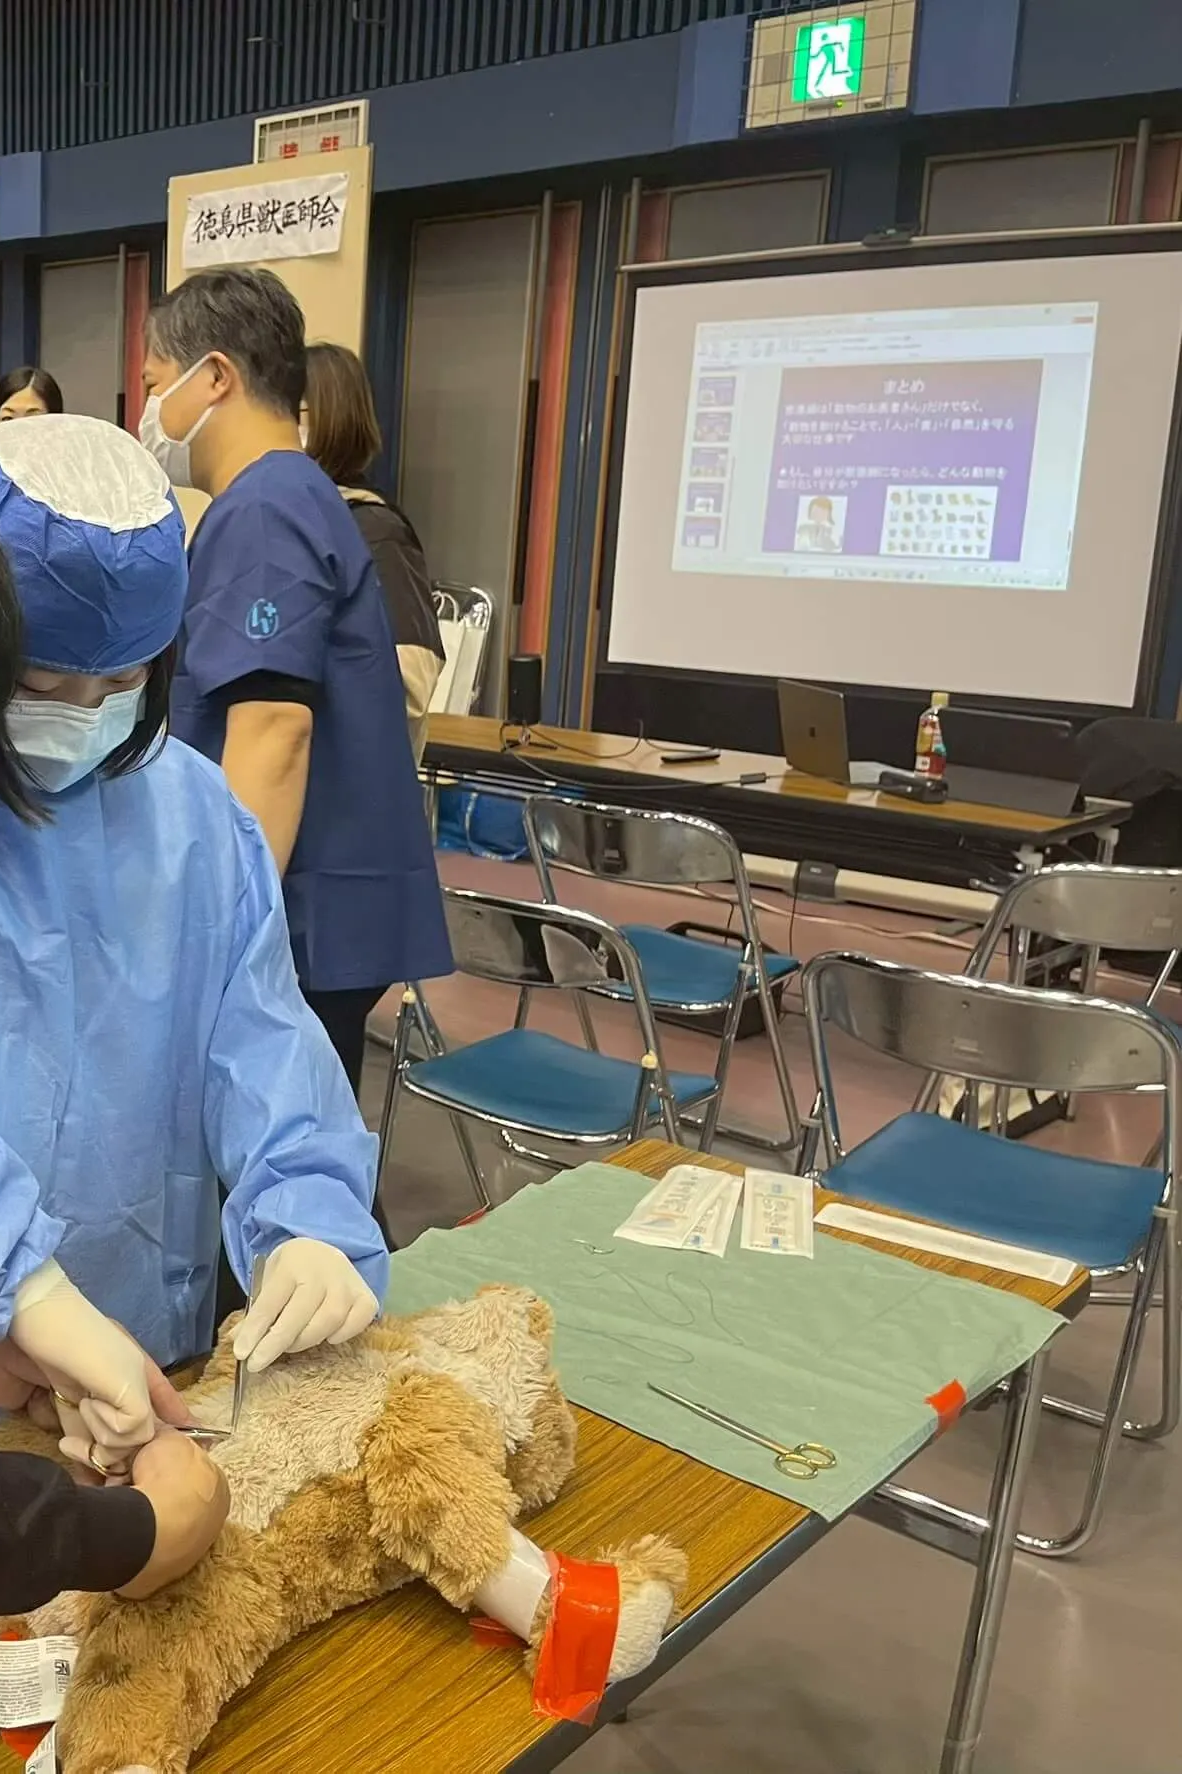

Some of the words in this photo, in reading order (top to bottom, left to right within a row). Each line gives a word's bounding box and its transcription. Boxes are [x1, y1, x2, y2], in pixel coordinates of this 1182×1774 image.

[194, 195, 340, 243] 徳島県獣医師会
[882, 378, 925, 396] まとめ
